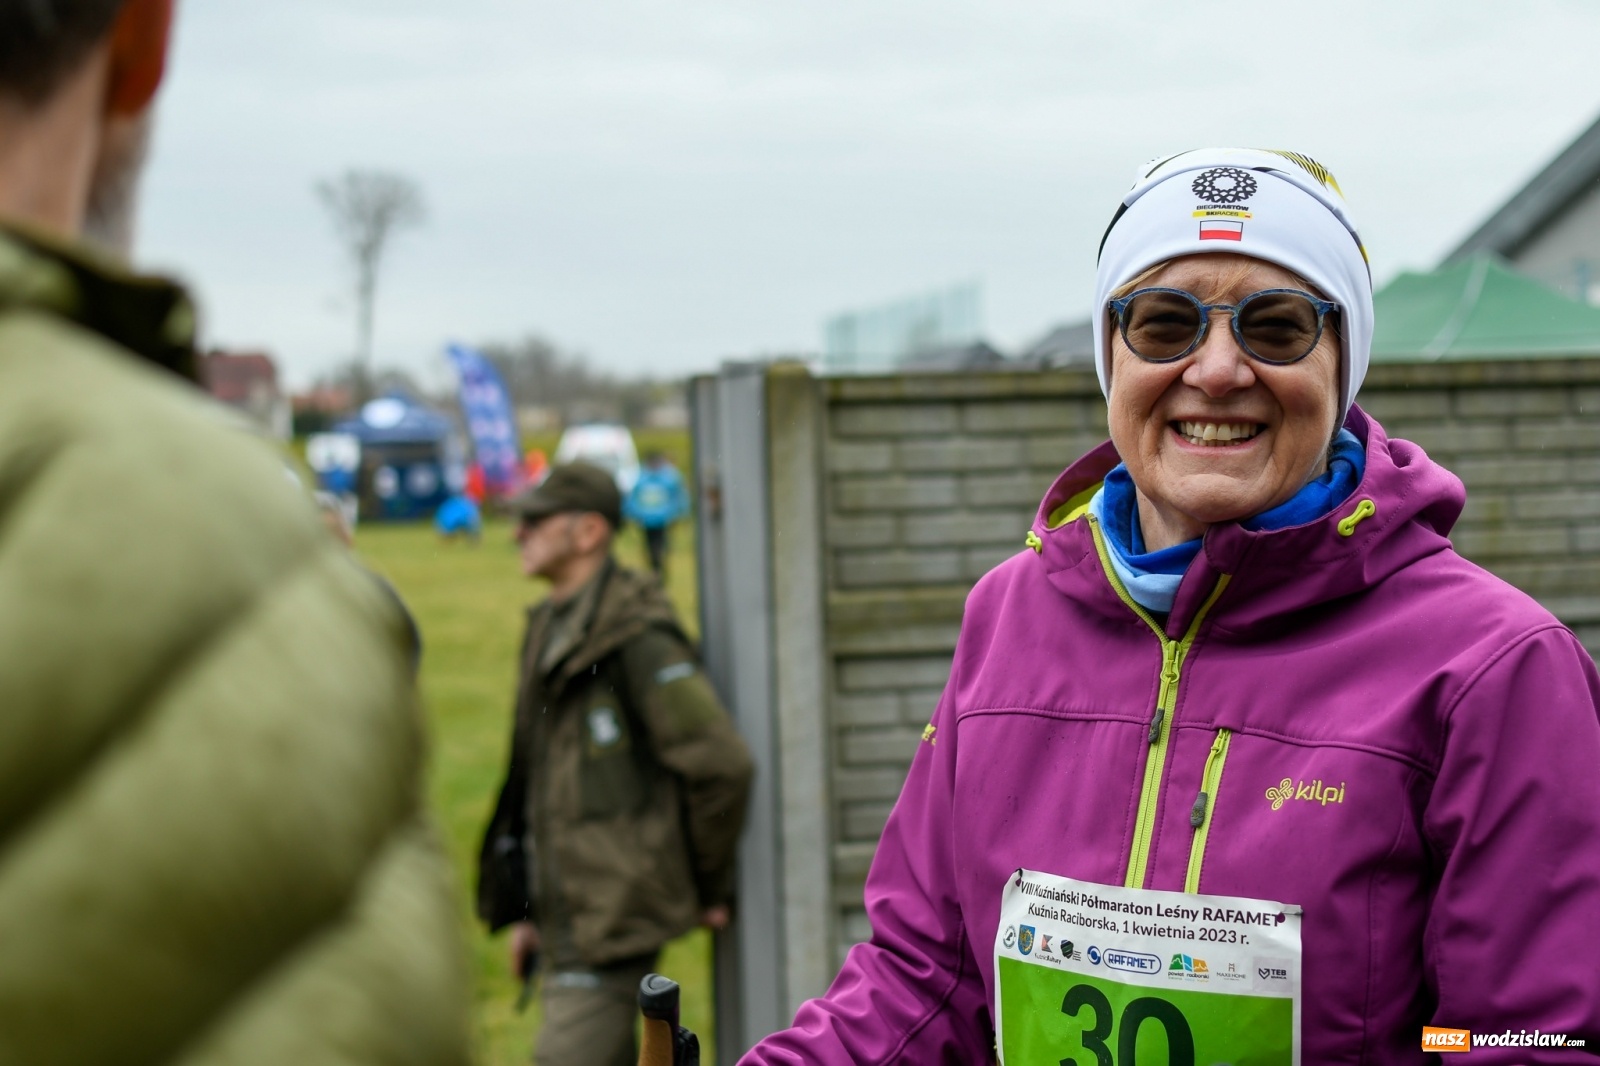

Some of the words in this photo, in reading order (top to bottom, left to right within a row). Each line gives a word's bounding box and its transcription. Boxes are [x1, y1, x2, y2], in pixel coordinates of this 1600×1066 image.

[1294, 780, 1346, 806] kilpi
[1034, 884, 1080, 906] Kuźniański
[1081, 893, 1153, 917] Półmaraton
[1156, 903, 1199, 923] Leśny
[1202, 906, 1280, 928] RAFAMET
[1028, 902, 1059, 921] Kuźnia
[1060, 908, 1120, 935] Raciborska,
[1122, 920, 1130, 934] 1
[1132, 921, 1195, 941] kwietnia
[1199, 927, 1237, 944] 2023
[1240, 934, 1250, 946] r.
[1107, 953, 1156, 970] RAFAMET
[1271, 968, 1287, 976] TEB
